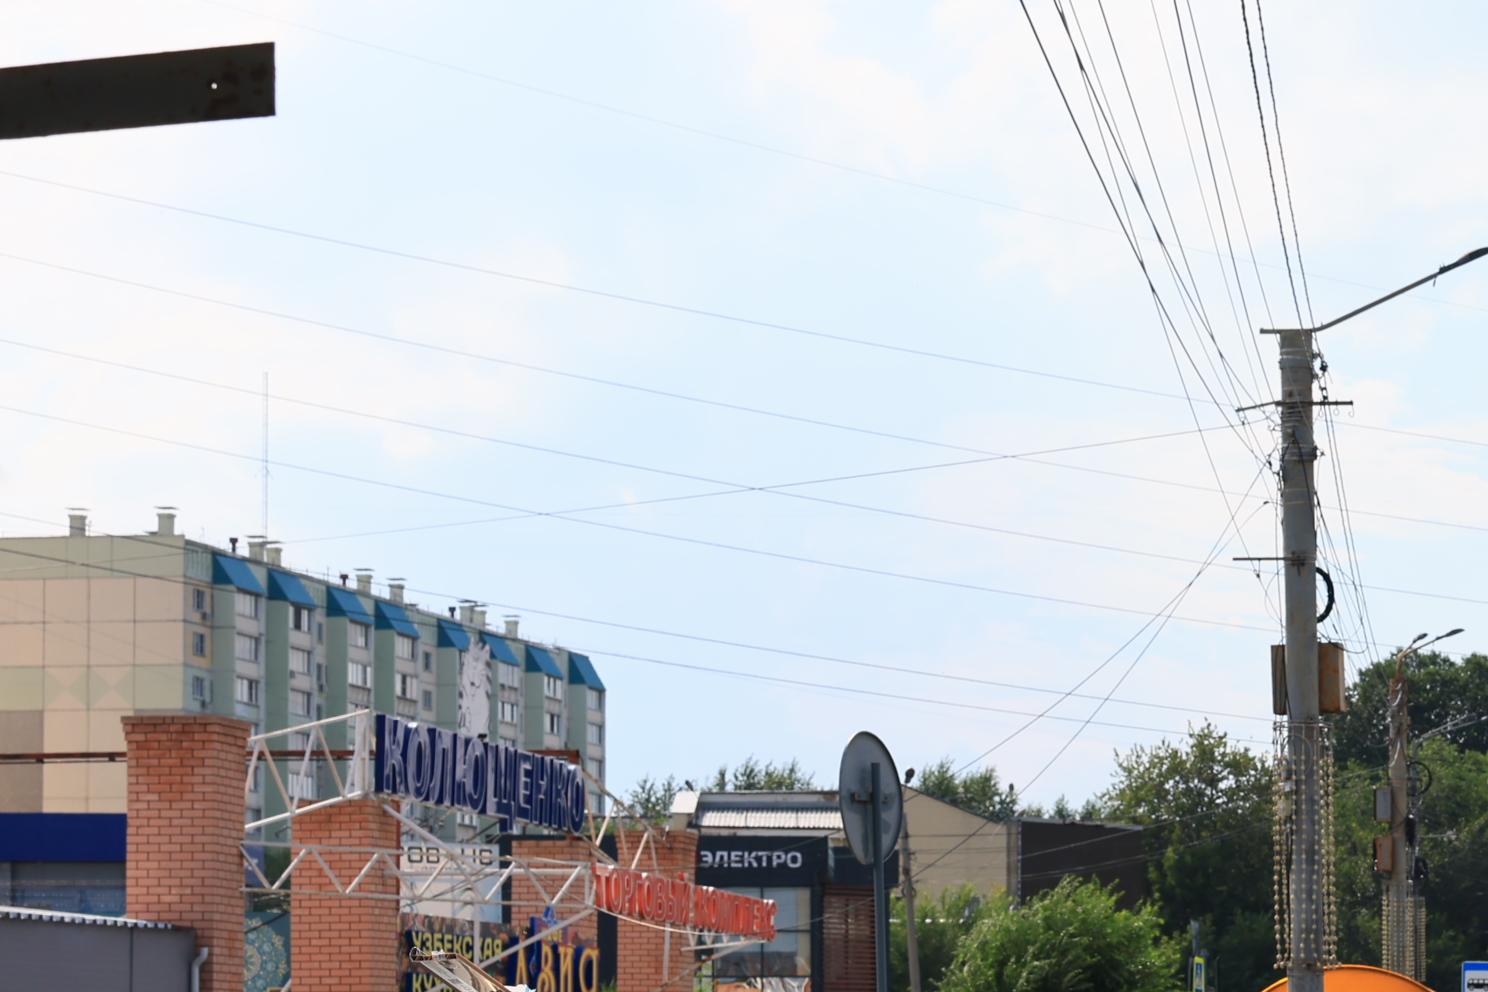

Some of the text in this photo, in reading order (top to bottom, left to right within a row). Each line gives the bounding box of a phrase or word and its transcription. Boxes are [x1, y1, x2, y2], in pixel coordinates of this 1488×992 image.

[376, 714, 585, 834] КОЛЮЩЕНКО
[701, 851, 802, 868] ЭЛЕКТРО
[592, 862, 696, 927] ТОРГОВЫЙ
